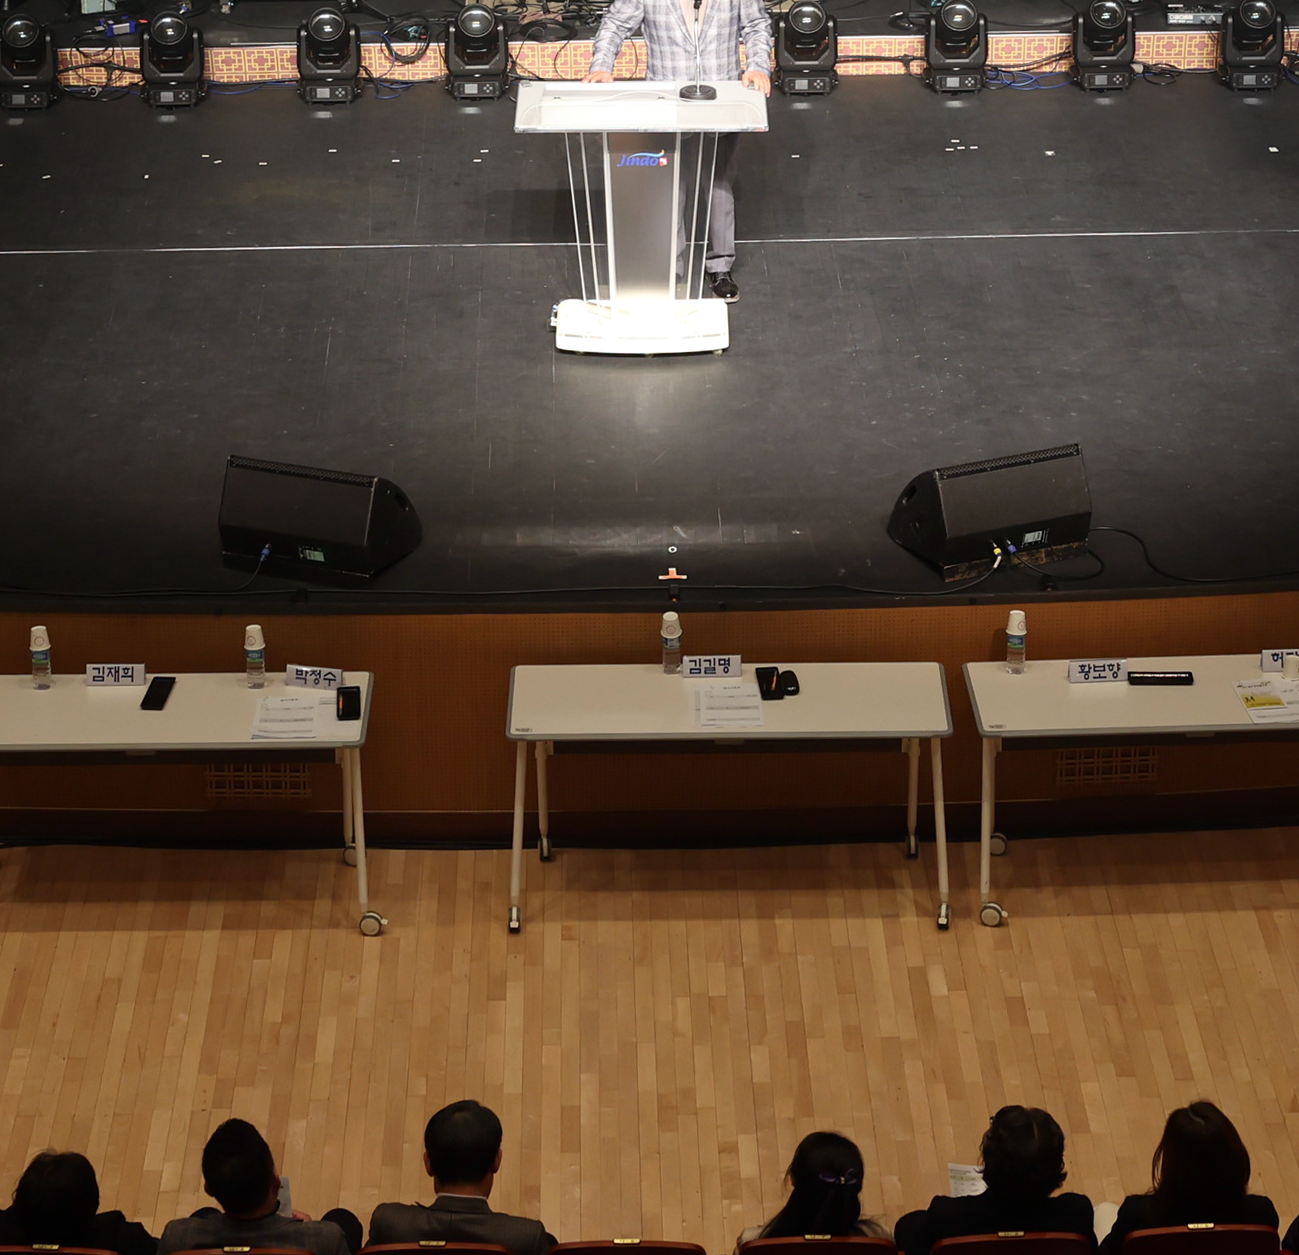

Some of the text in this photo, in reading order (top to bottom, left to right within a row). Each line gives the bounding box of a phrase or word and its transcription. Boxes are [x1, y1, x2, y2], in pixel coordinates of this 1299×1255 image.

[616, 153, 661, 167] Jindo
[92, 666, 134, 682] 김재희
[689, 658, 731, 674] 김길명
[295, 669, 337, 687] 박정수
